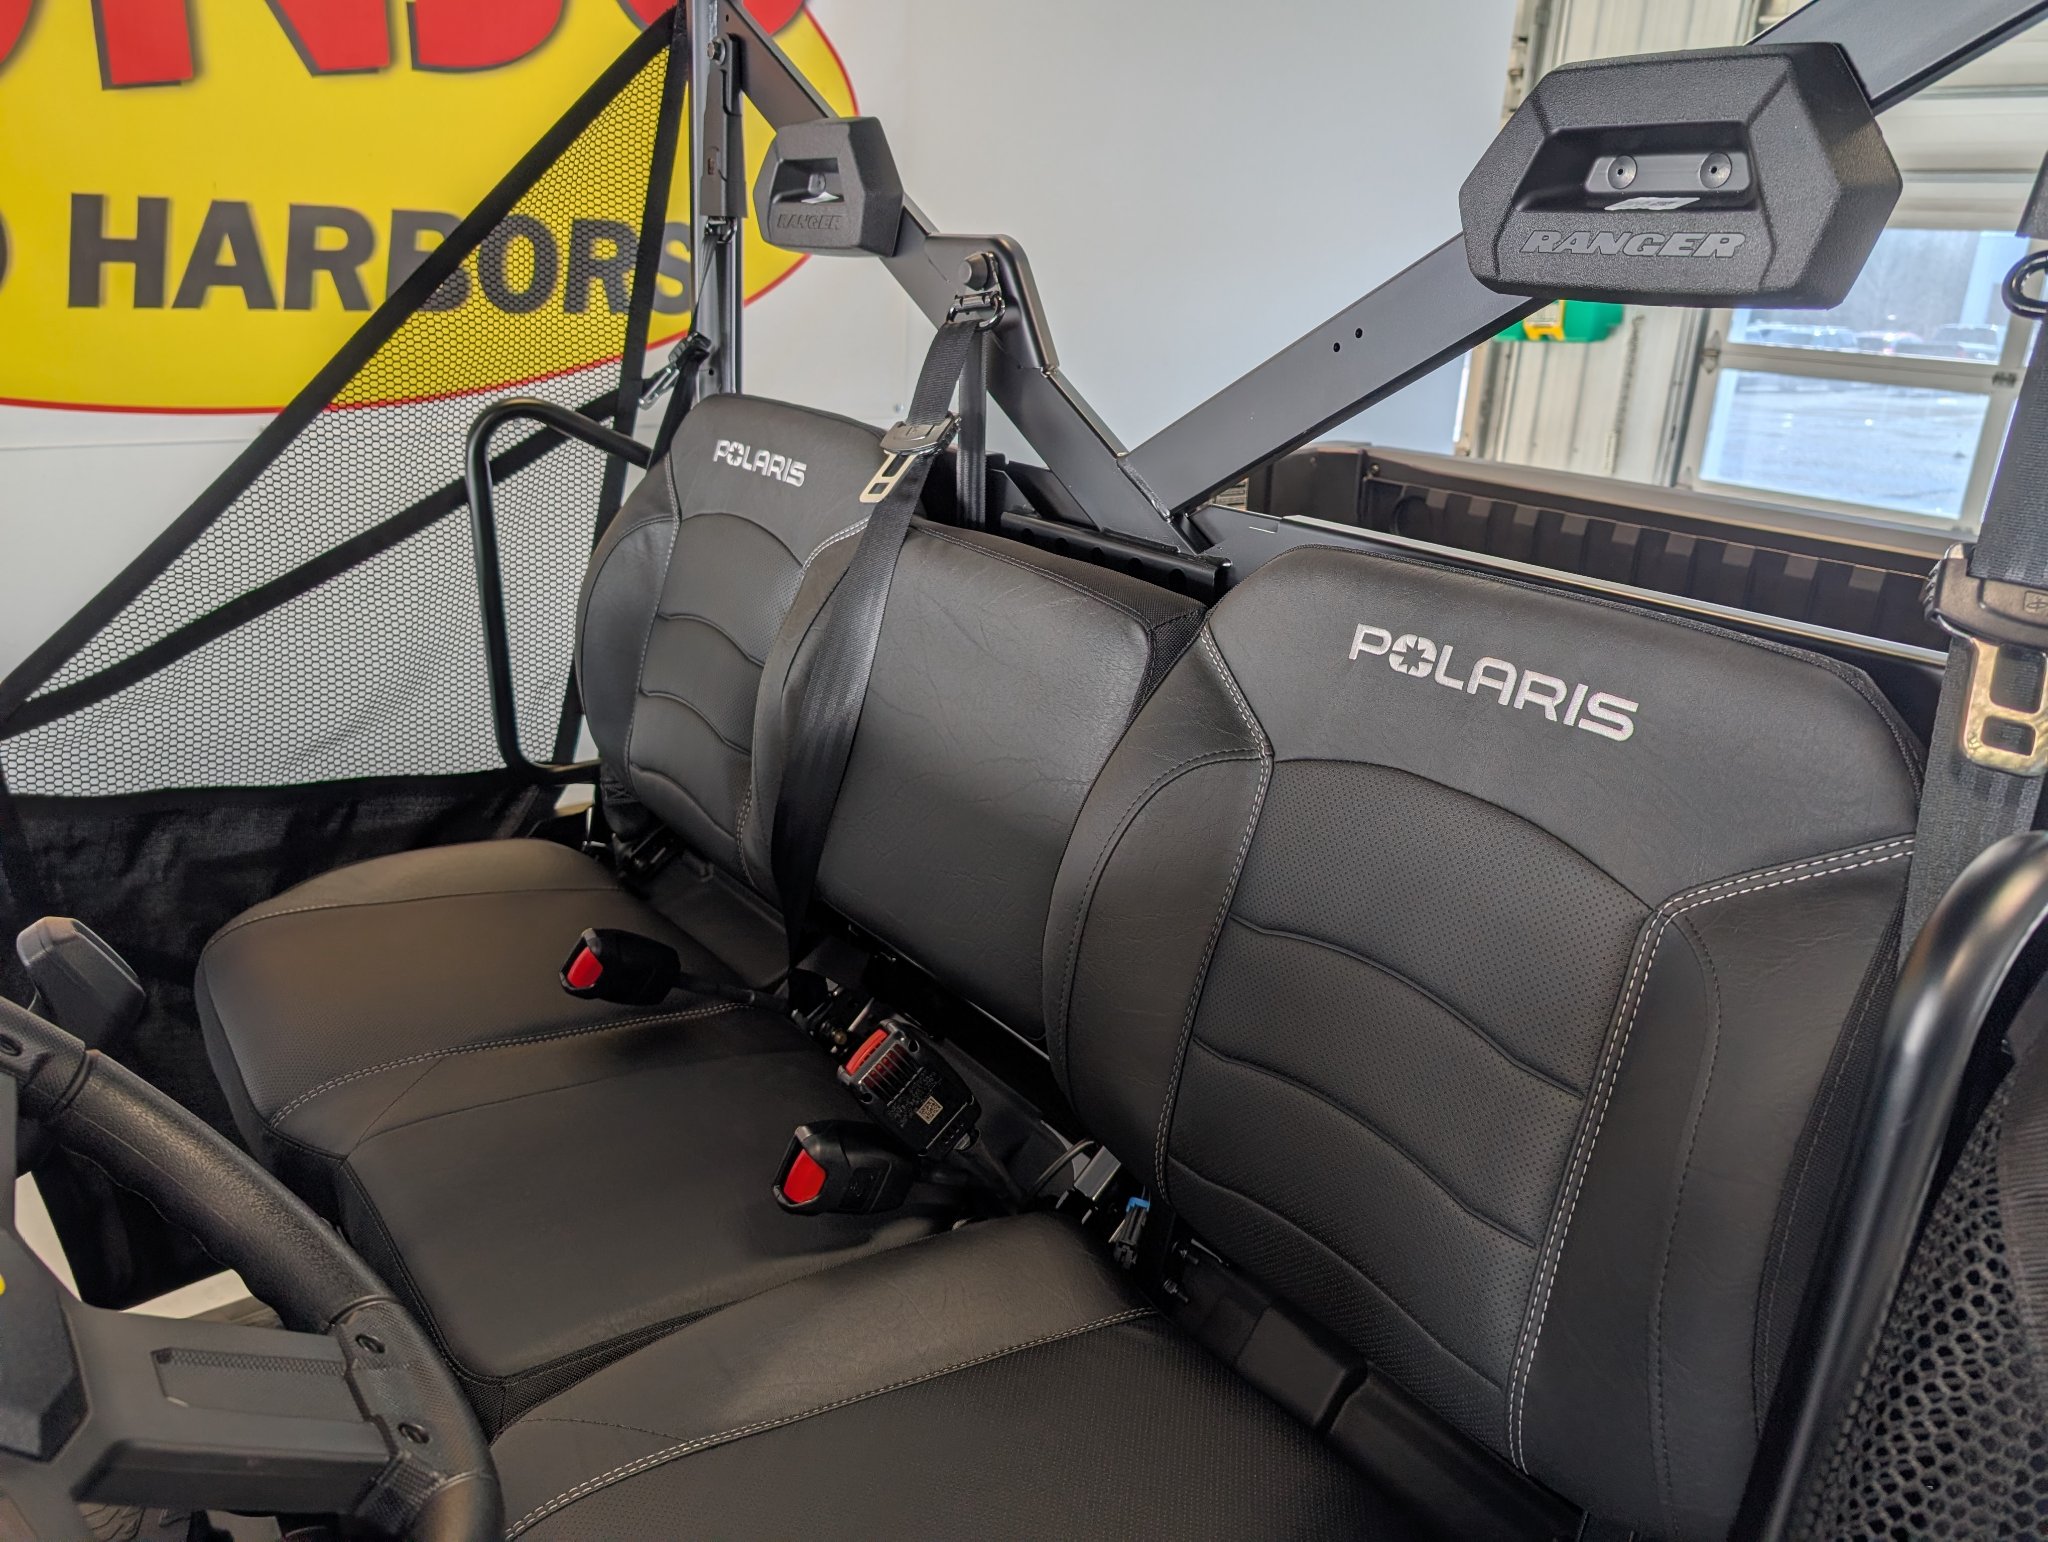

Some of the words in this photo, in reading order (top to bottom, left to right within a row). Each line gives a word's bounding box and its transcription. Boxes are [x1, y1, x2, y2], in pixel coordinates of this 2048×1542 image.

[776, 213, 843, 230] RANGER
[1518, 229, 1747, 259] RANGER
[713, 439, 807, 487] POLARIS
[1348, 622, 1640, 742] POLARIS
